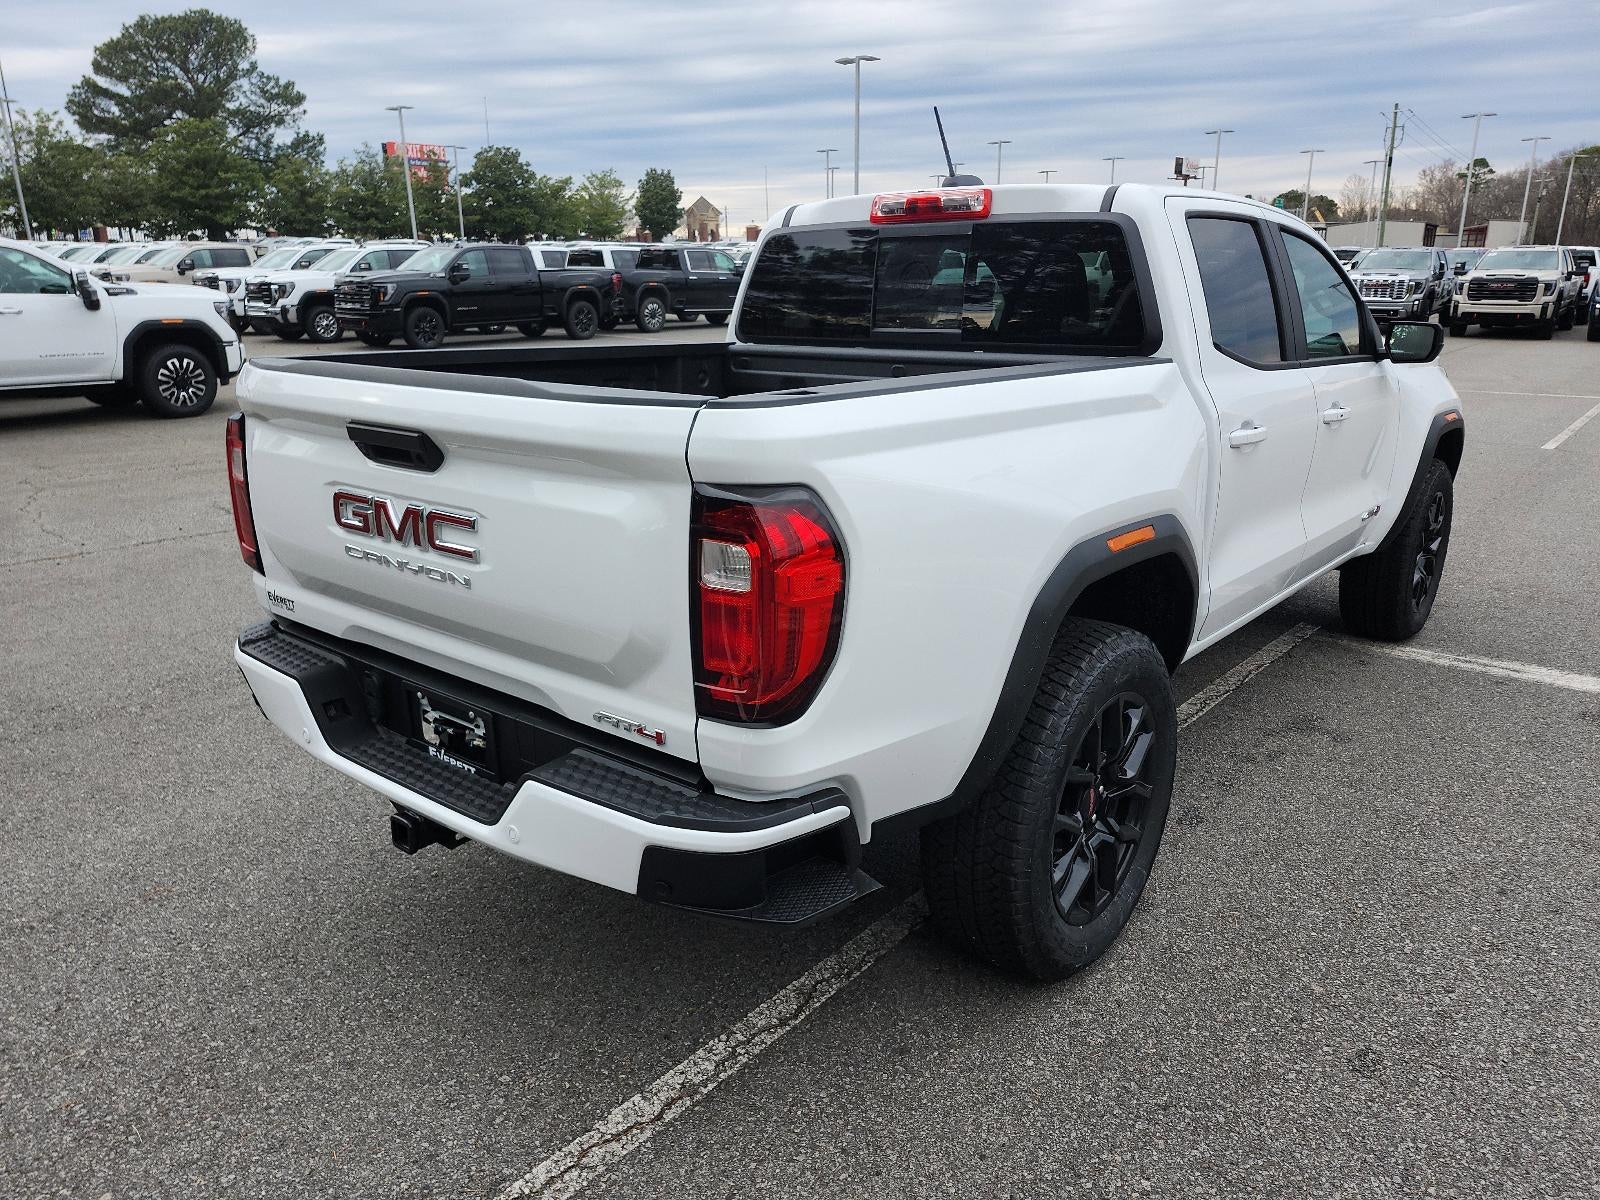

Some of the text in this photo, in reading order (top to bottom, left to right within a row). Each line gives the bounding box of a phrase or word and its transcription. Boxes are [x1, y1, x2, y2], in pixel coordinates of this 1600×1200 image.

[333, 488, 480, 564] GMC
[344, 543, 472, 590] CANYON
[593, 710, 667, 746] AT4
